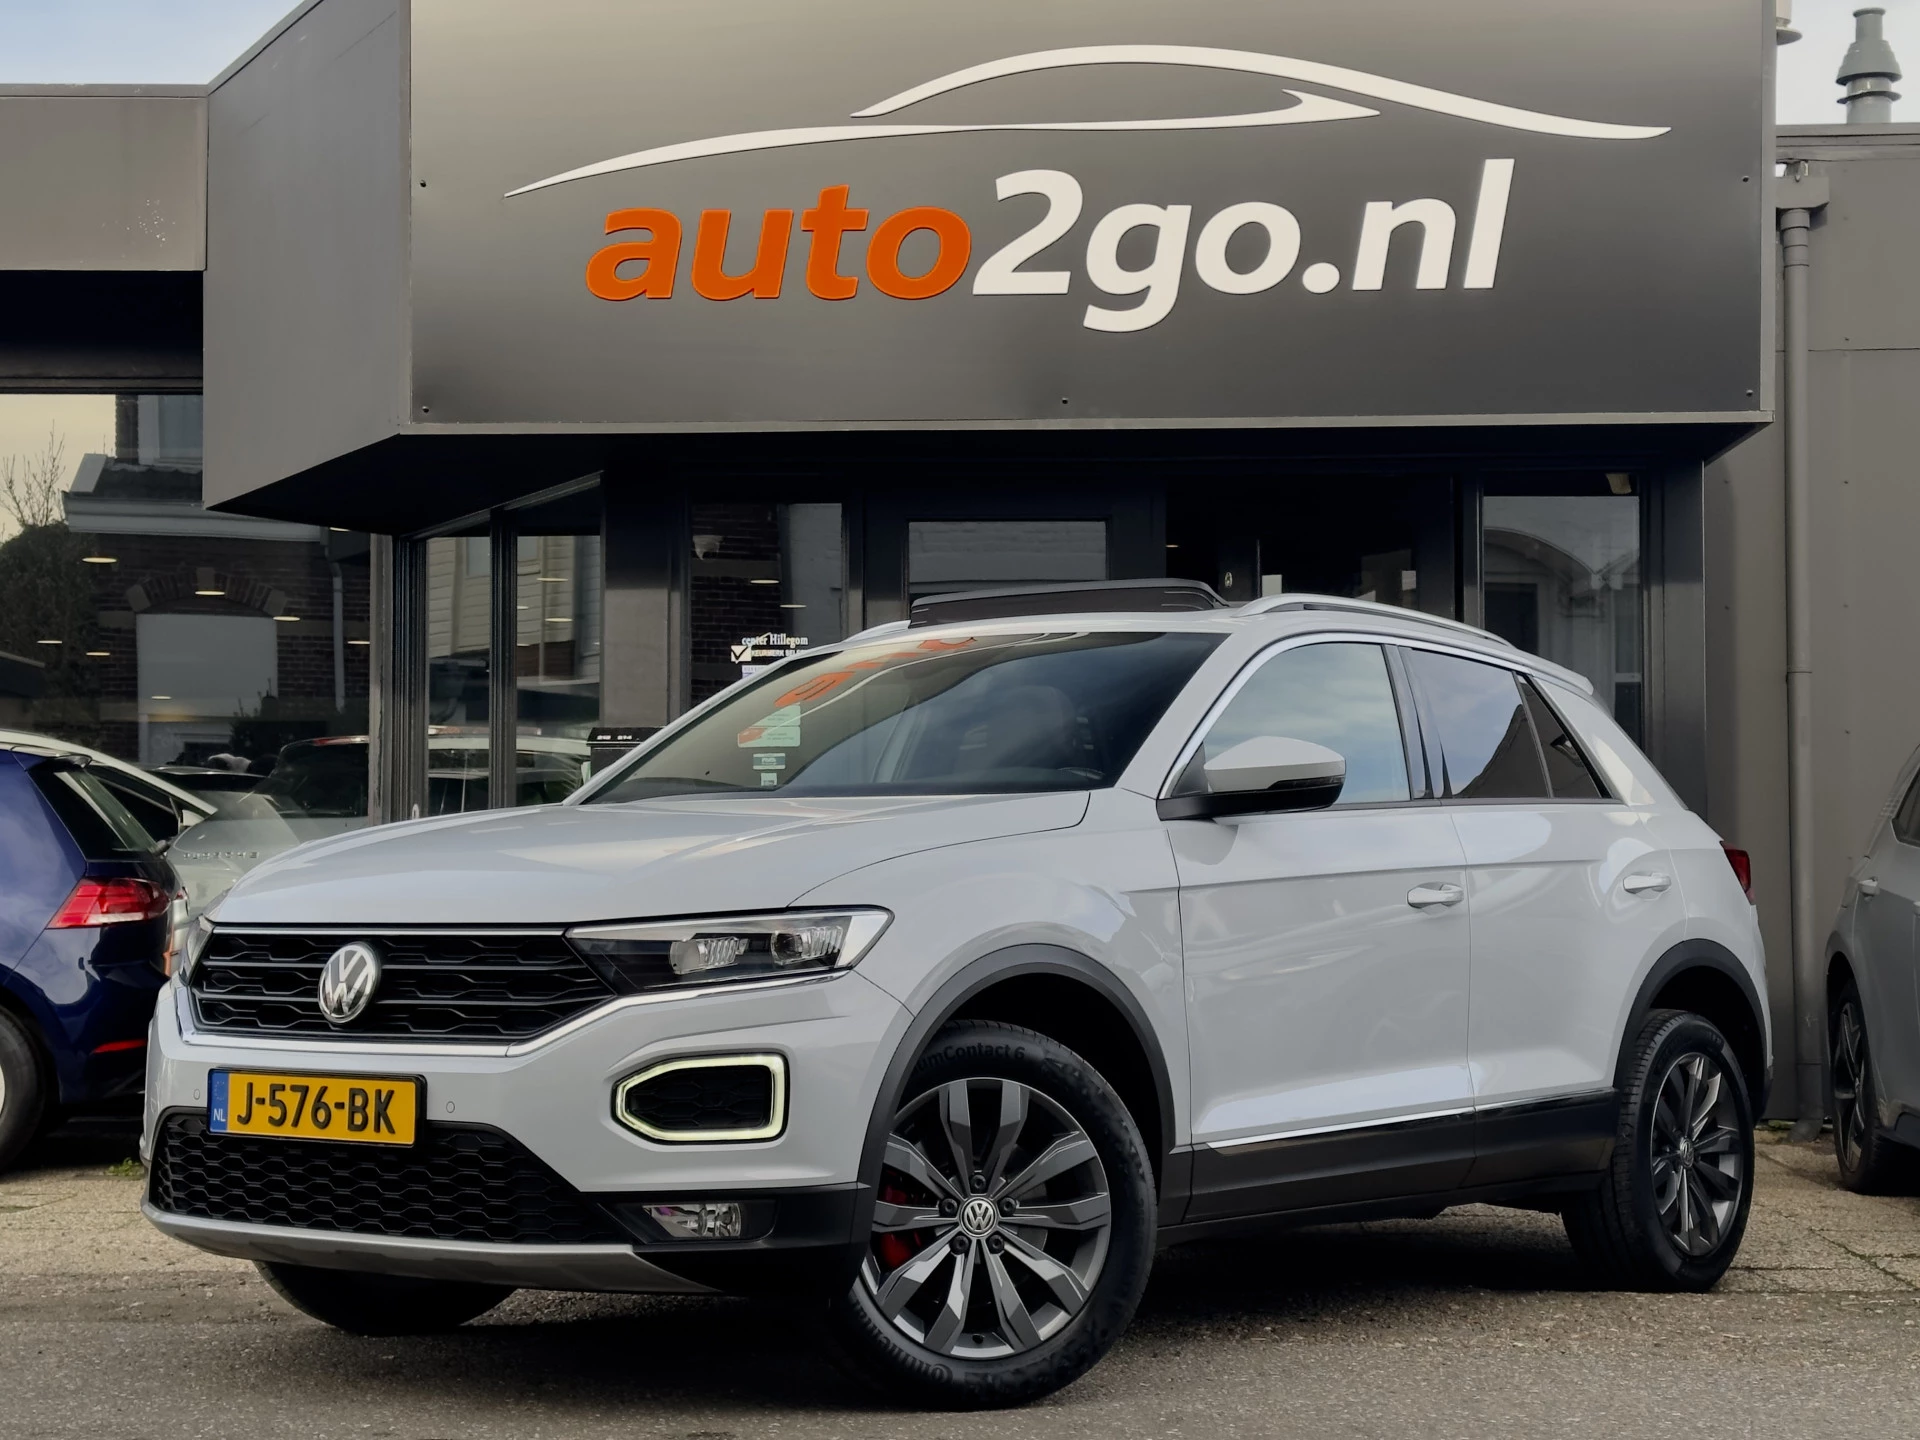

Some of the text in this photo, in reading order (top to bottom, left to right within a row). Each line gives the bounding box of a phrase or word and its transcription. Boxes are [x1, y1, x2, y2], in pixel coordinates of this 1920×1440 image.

[586, 159, 1515, 332] auto2go.nl
[769, 633, 808, 648] Hillegom
[213, 1107, 226, 1122] NL
[236, 1082, 396, 1134] J-576-BK
